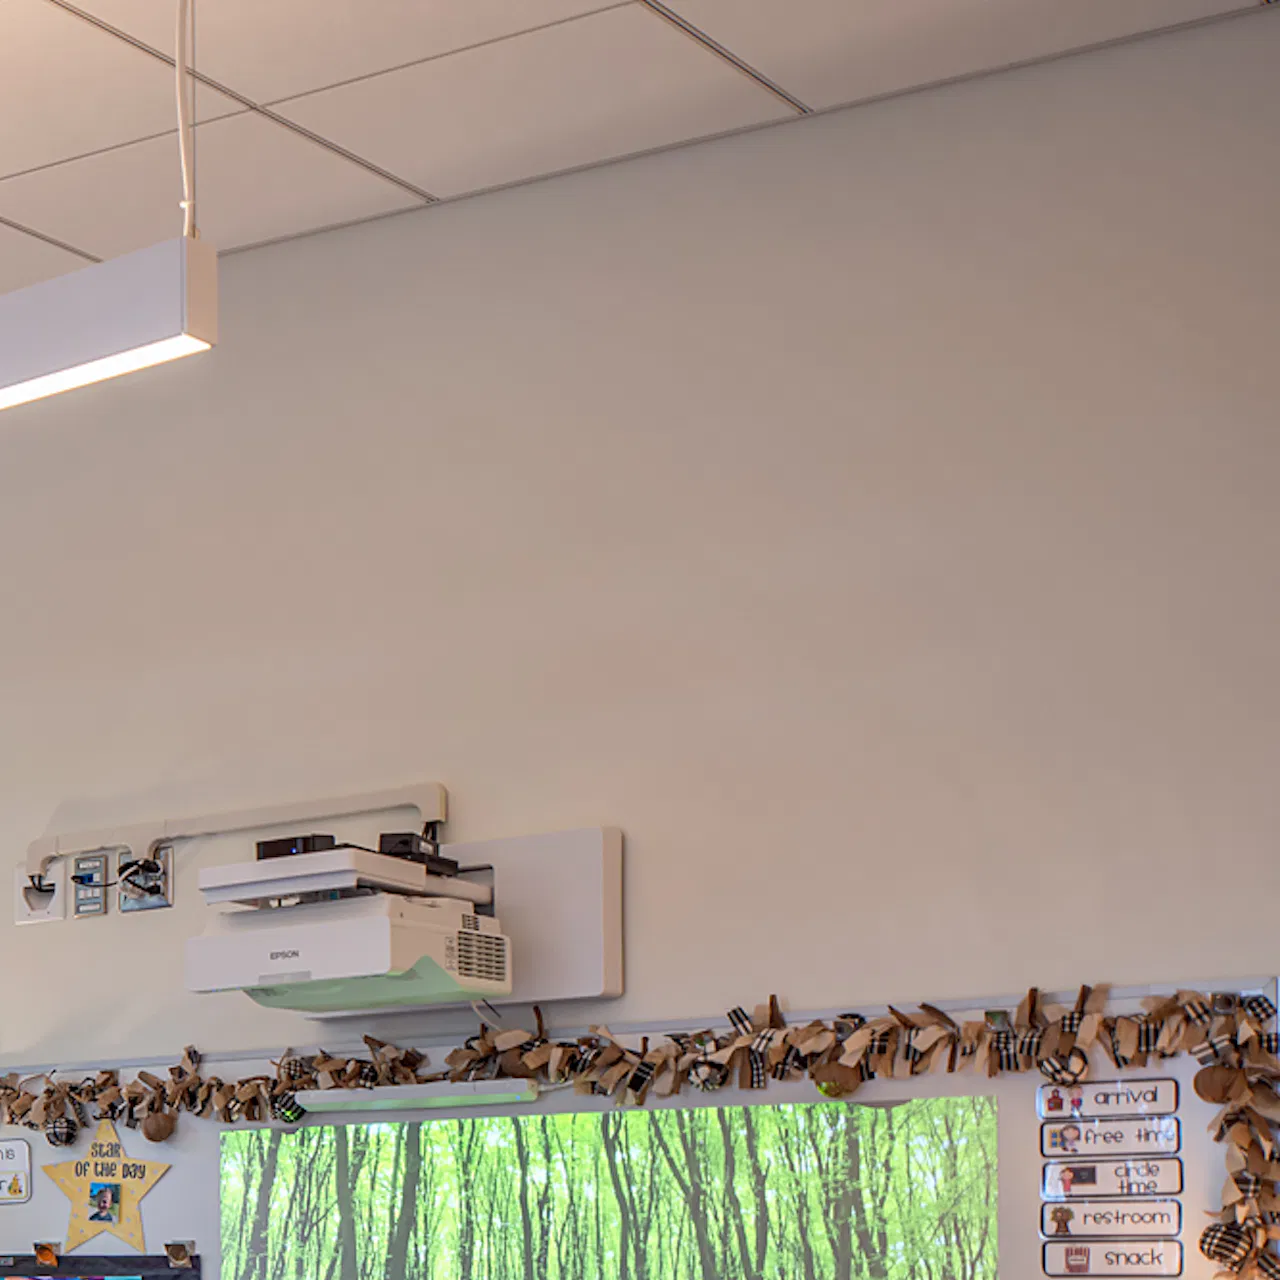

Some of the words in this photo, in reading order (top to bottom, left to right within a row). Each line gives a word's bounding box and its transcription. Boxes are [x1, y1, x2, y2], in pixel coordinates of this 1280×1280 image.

[269, 950, 299, 961] EPSON
[1094, 1086, 1158, 1105] arrival
[1084, 1128, 1124, 1144] free
[5, 1148, 16, 1160] is
[1114, 1162, 1160, 1177] circle
[1118, 1179, 1158, 1194] time
[1083, 1209, 1171, 1226] restroom
[1104, 1249, 1163, 1266] snack
